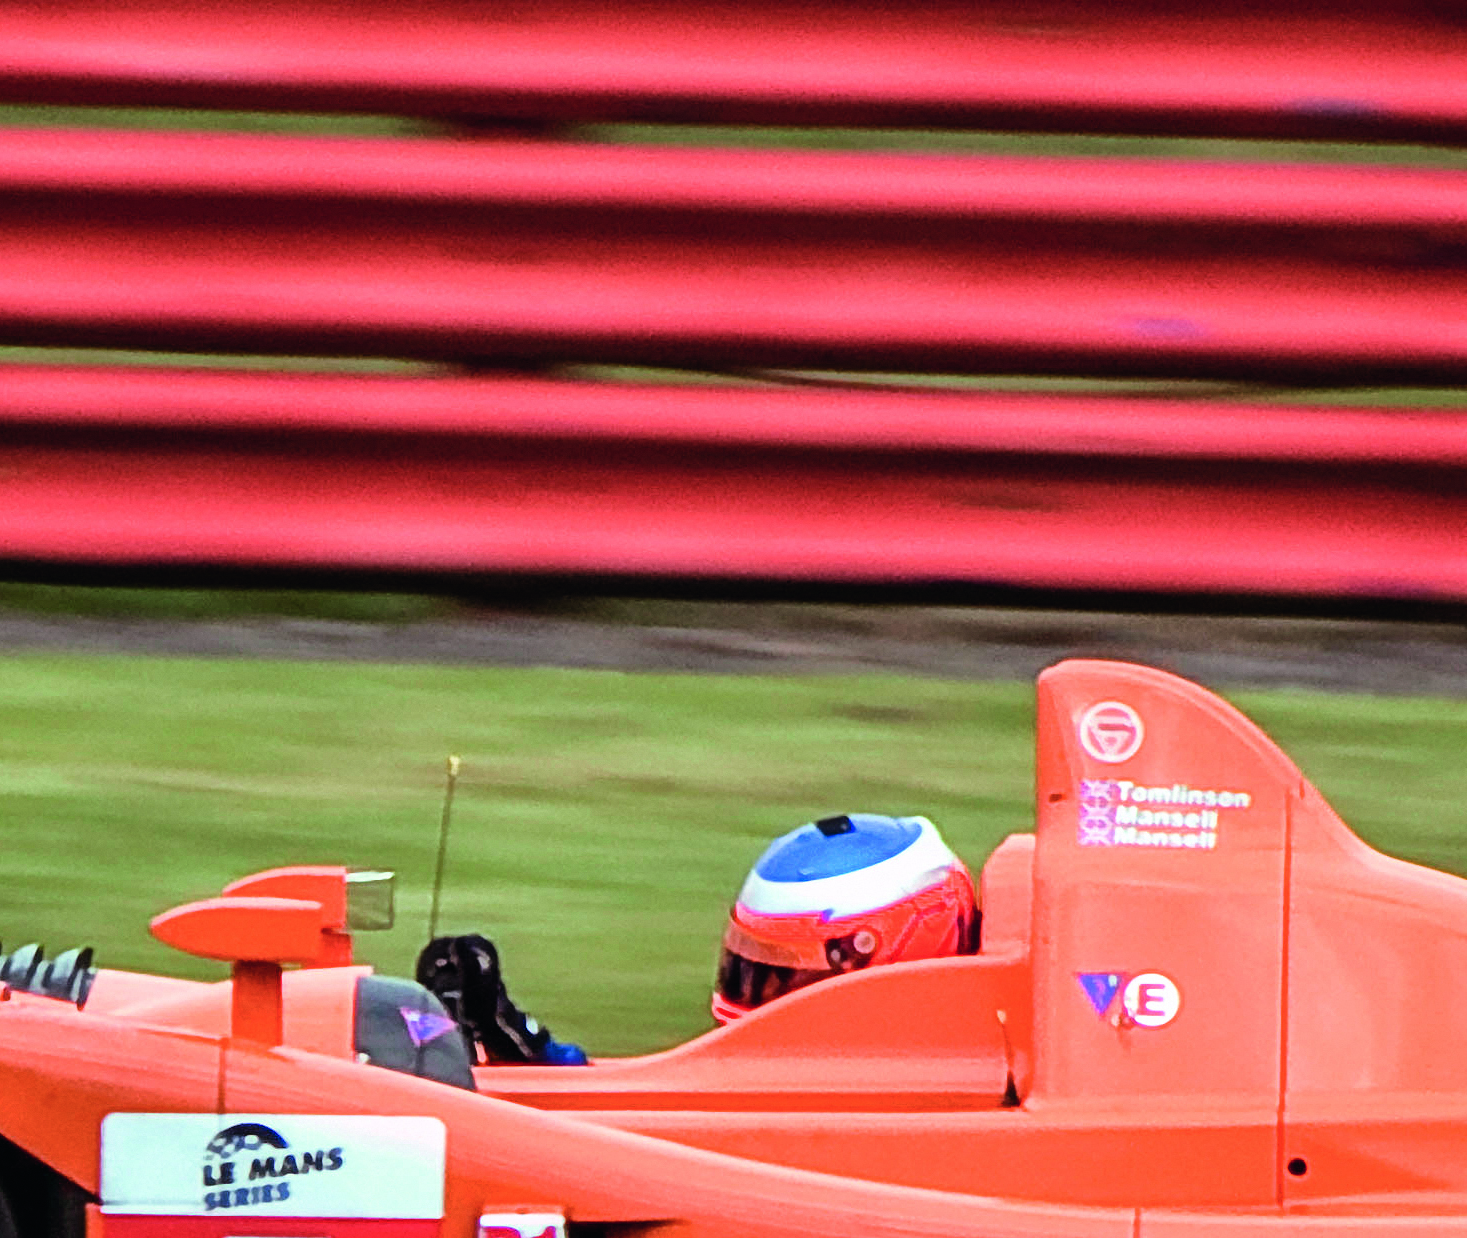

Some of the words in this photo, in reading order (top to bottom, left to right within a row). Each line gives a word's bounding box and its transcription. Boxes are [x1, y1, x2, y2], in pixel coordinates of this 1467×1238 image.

[1117, 780, 1251, 808] Tomlinson
[1115, 805, 1218, 829] Mansell
[1113, 826, 1216, 849] Mansell
[1136, 983, 1166, 1017] E
[203, 1162, 235, 1187] LE
[248, 1147, 344, 1181] MANS
[203, 1182, 290, 1211] SERIES
